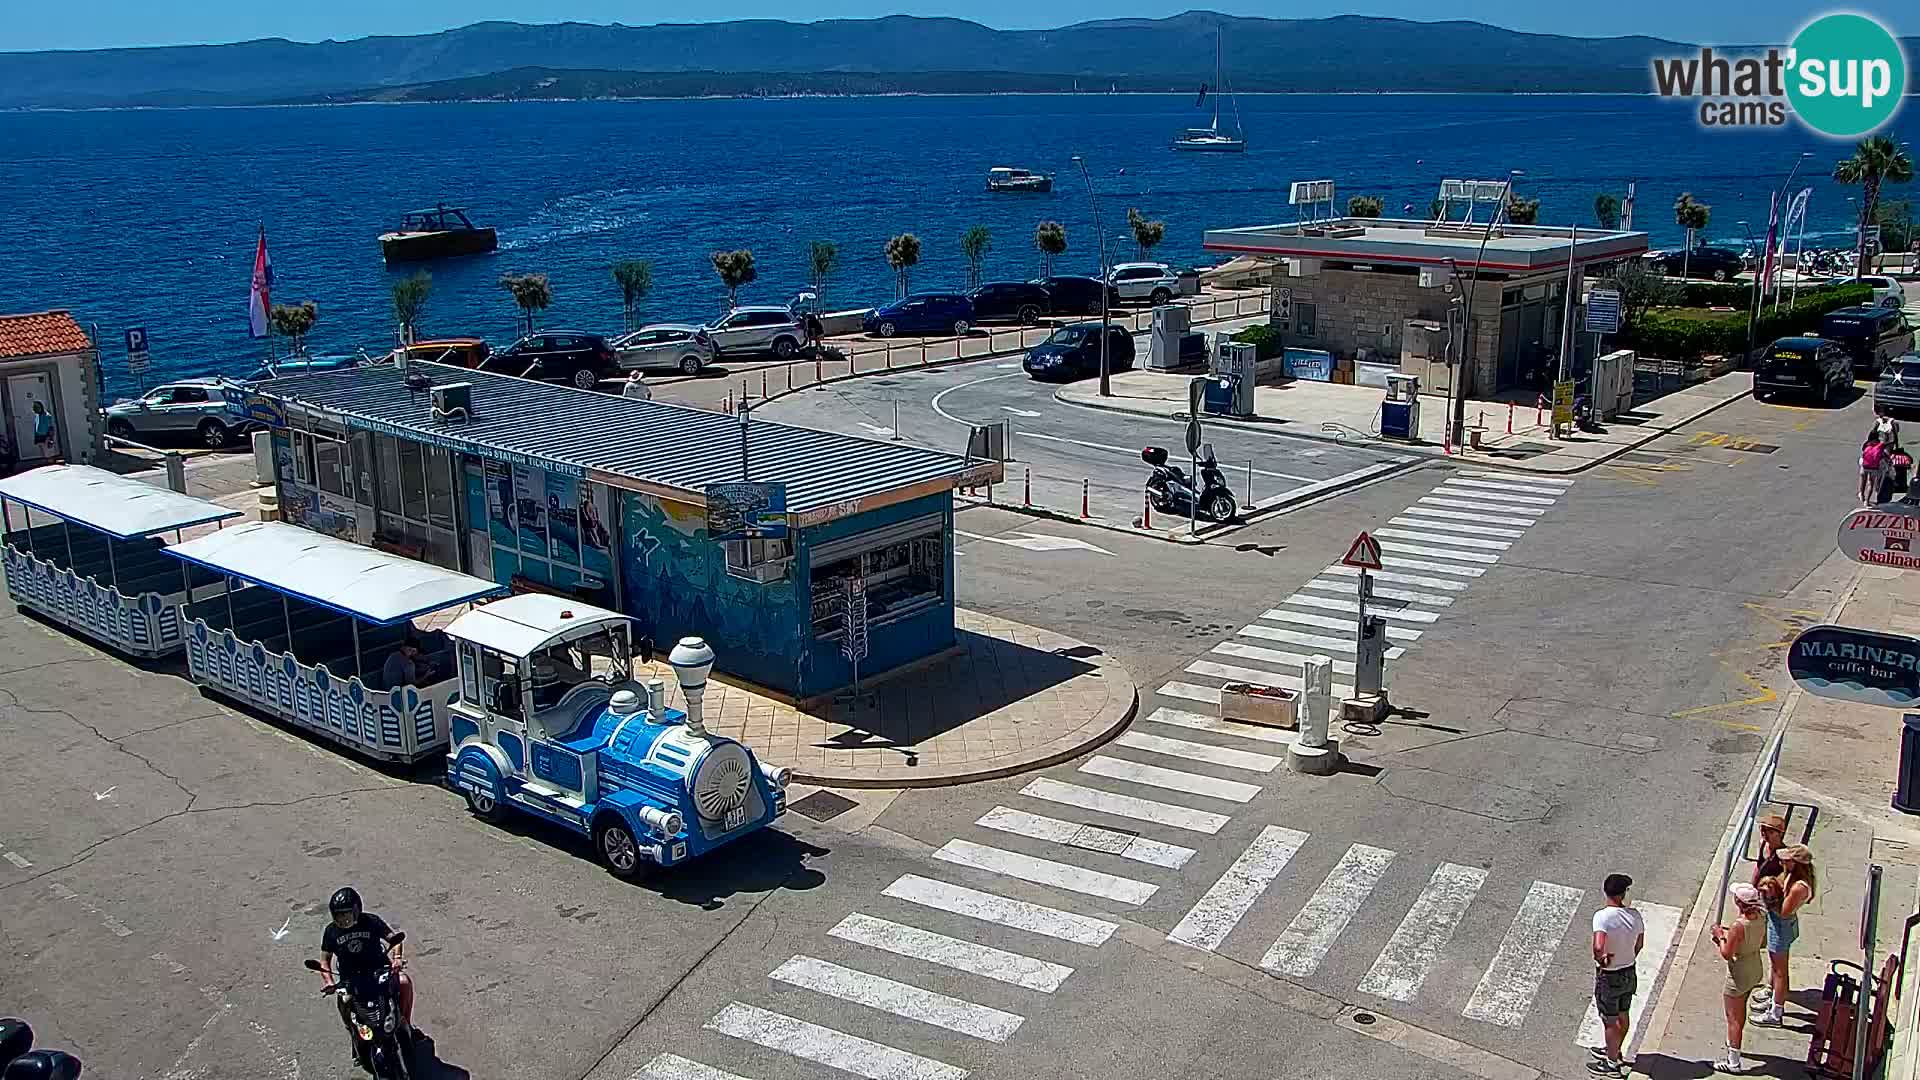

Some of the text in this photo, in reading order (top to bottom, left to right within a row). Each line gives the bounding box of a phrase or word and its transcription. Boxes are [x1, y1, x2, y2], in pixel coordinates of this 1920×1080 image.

[130, 331, 142, 348] P
[494, 449, 526, 465] STATION
[528, 457, 554, 472] TICKET
[555, 462, 582, 476] OFFICE
[1828, 661, 1896, 679] caffe bar
